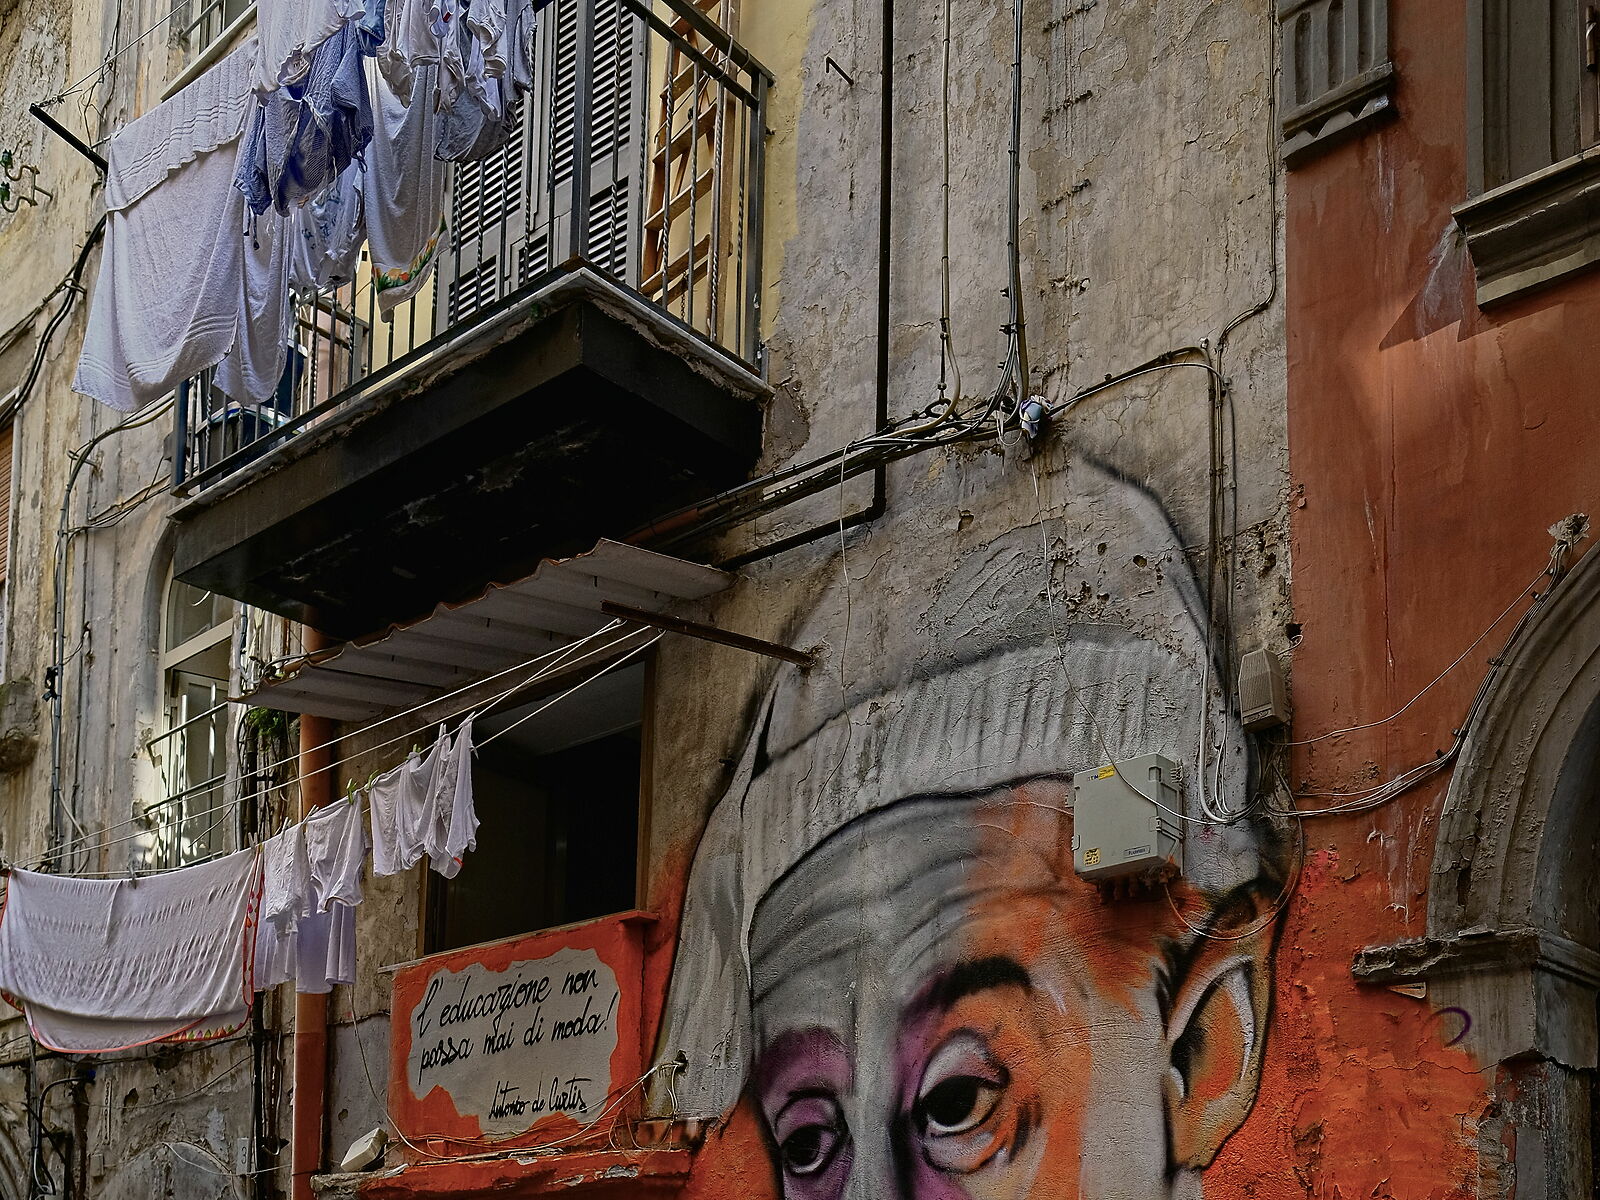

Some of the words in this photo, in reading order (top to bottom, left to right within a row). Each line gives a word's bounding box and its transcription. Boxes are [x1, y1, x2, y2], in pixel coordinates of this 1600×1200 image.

[562, 969, 599, 995] non
[418, 1037, 474, 1085] passa
[483, 1021, 515, 1054] mai
[524, 1006, 545, 1046] di
[551, 991, 618, 1042] moda!
[532, 1079, 546, 1112] de
[549, 1075, 592, 1113] Curtis
